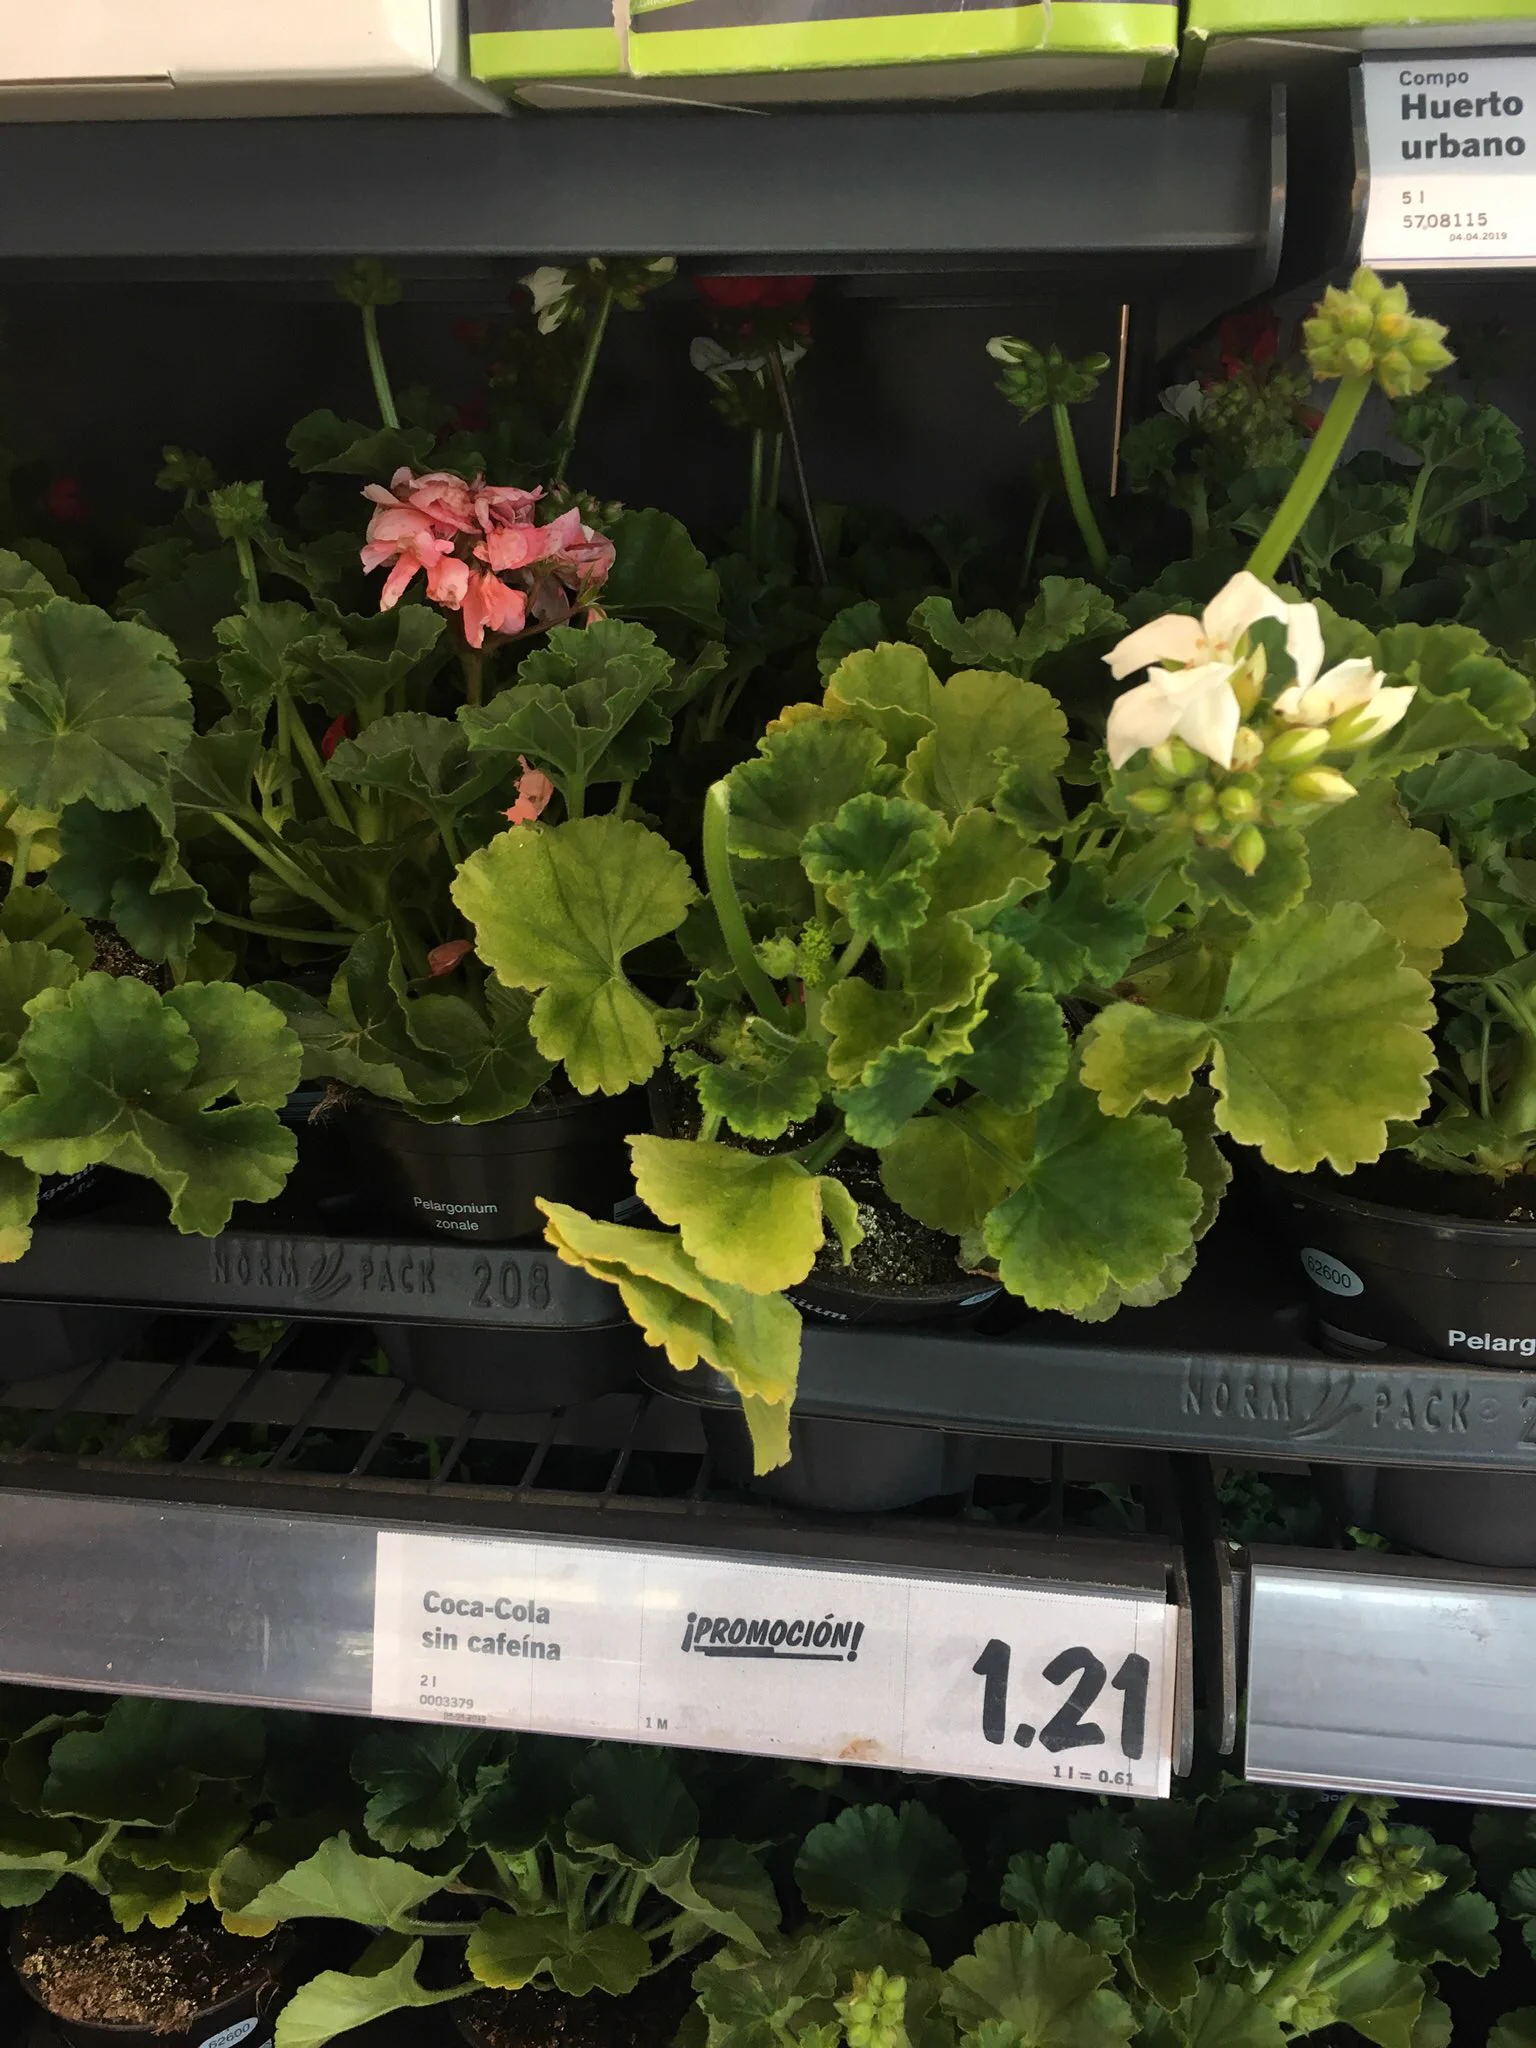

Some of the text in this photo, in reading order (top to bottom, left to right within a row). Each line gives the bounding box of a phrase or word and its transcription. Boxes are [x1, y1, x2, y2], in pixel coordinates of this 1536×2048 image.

[1400, 70, 1469, 87] Compo
[1401, 91, 1524, 120] Huerto
[1401, 132, 1526, 160] urbano
[1402, 191, 1412, 205] 5
[1403, 212, 1488, 229] 5708115
[1449, 232, 1508, 242] 04.04.2019
[413, 1196, 498, 1215] Pelargonium
[436, 1219, 479, 1231] zonale
[359, 1252, 436, 1294] PACK
[472, 1259, 552, 1310] 208
[1307, 1255, 1352, 1288] 62600
[1371, 1384, 1471, 1434] PACK
[423, 1590, 550, 1624] Coca-Cola
[422, 1627, 561, 1661] sin cafeína
[681, 1612, 865, 1662] ¡PROMOCIÓN!
[420, 1675, 428, 1687] 2
[419, 1694, 474, 1709] 0003379
[972, 1638, 1151, 1760] 1.21
[646, 1717, 668, 1730] 1 M
[1054, 1765, 1061, 1778] 1
[1098, 1769, 1134, 1786] 0.61
[208, 2023, 250, 2048] 62600
